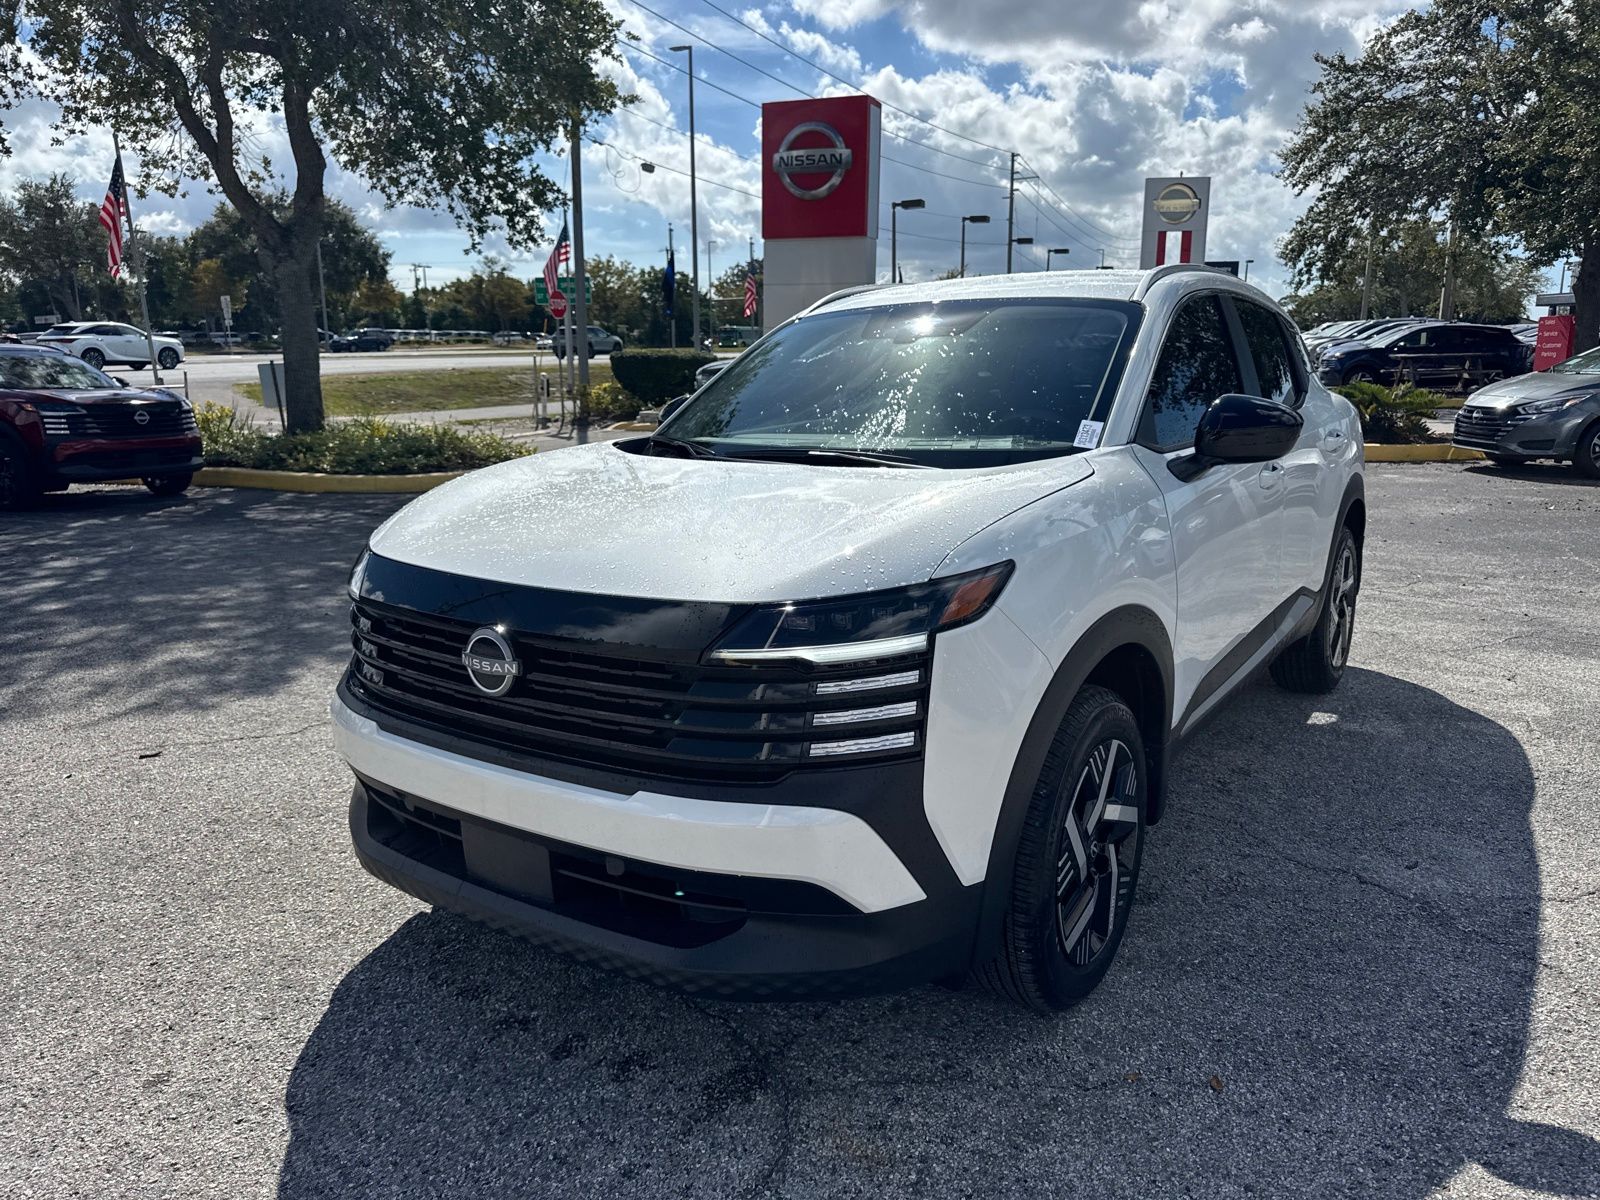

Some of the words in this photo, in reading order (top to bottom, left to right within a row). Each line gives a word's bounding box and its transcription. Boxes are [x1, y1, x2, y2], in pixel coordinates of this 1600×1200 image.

[778, 153, 843, 168] NISSAN
[550, 298, 567, 310] STOP
[462, 653, 516, 674] NISSAN
